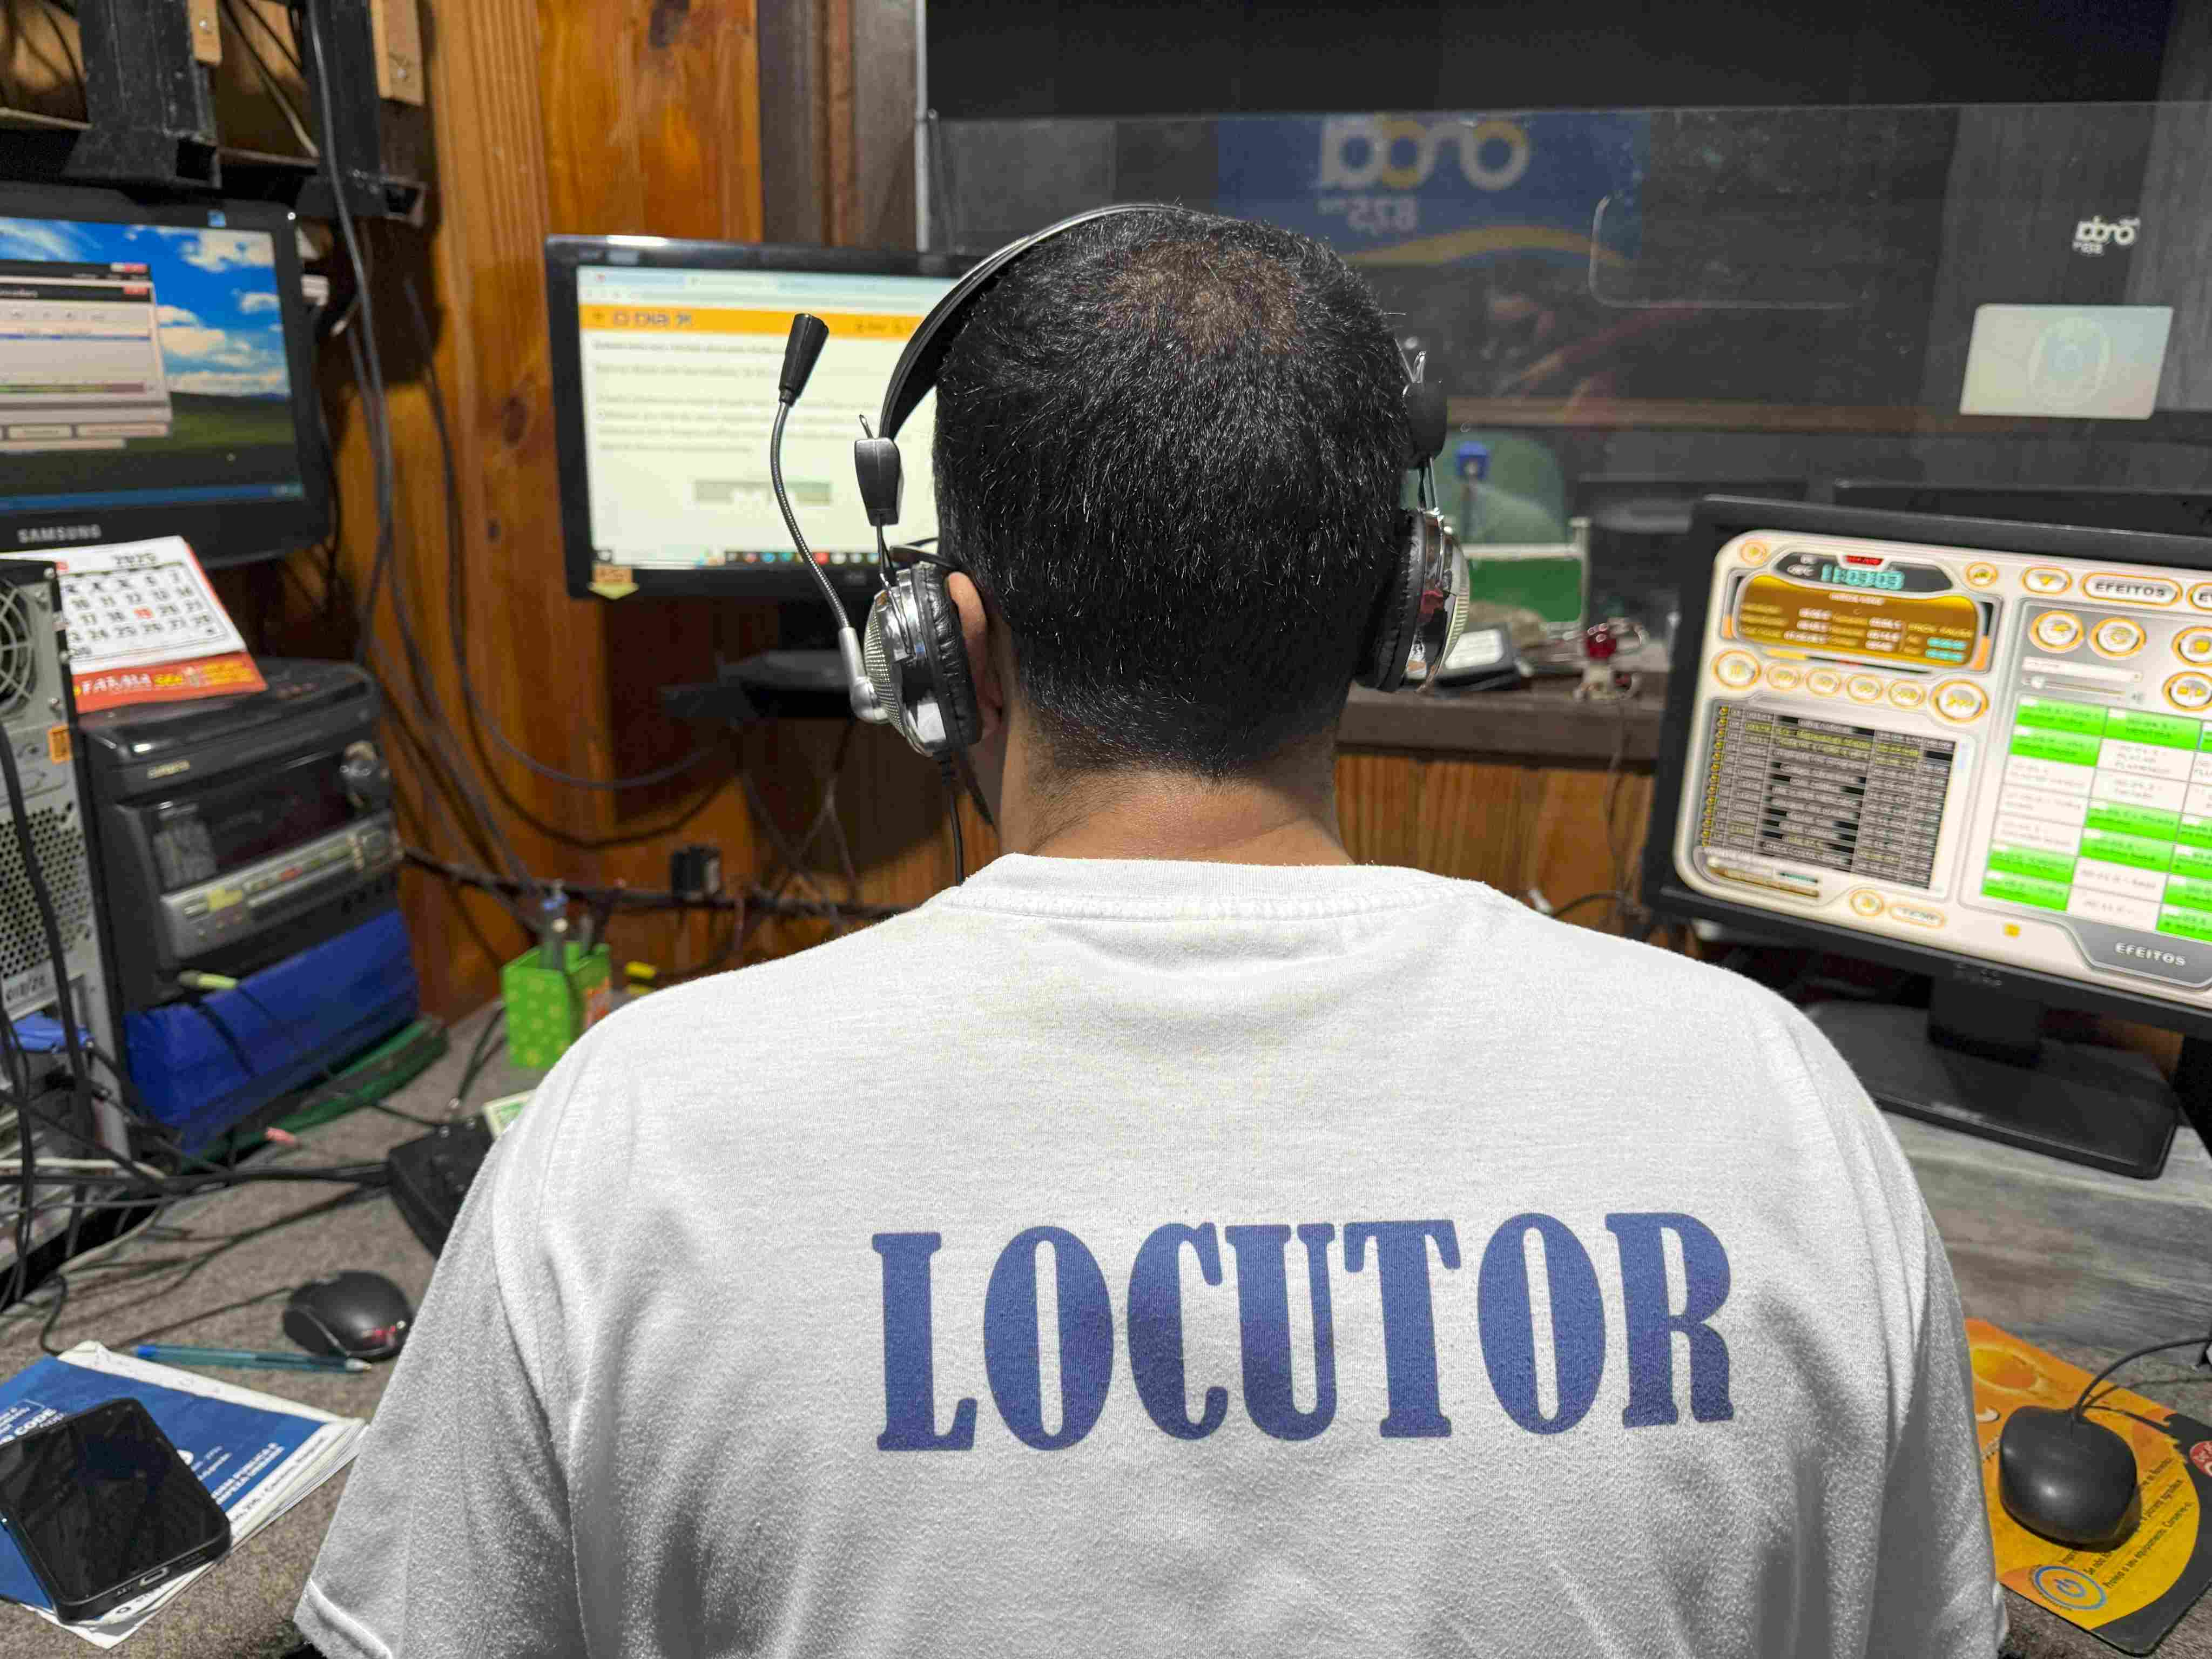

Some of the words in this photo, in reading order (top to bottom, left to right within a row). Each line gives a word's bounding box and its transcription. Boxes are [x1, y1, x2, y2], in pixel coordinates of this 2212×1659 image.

[17, 523, 102, 543] SAMSUNG
[2095, 582, 2166, 596] EFEITOS
[2115, 942, 2186, 966] EFEITOS
[871, 1212, 1735, 1452] LOCUTOR
